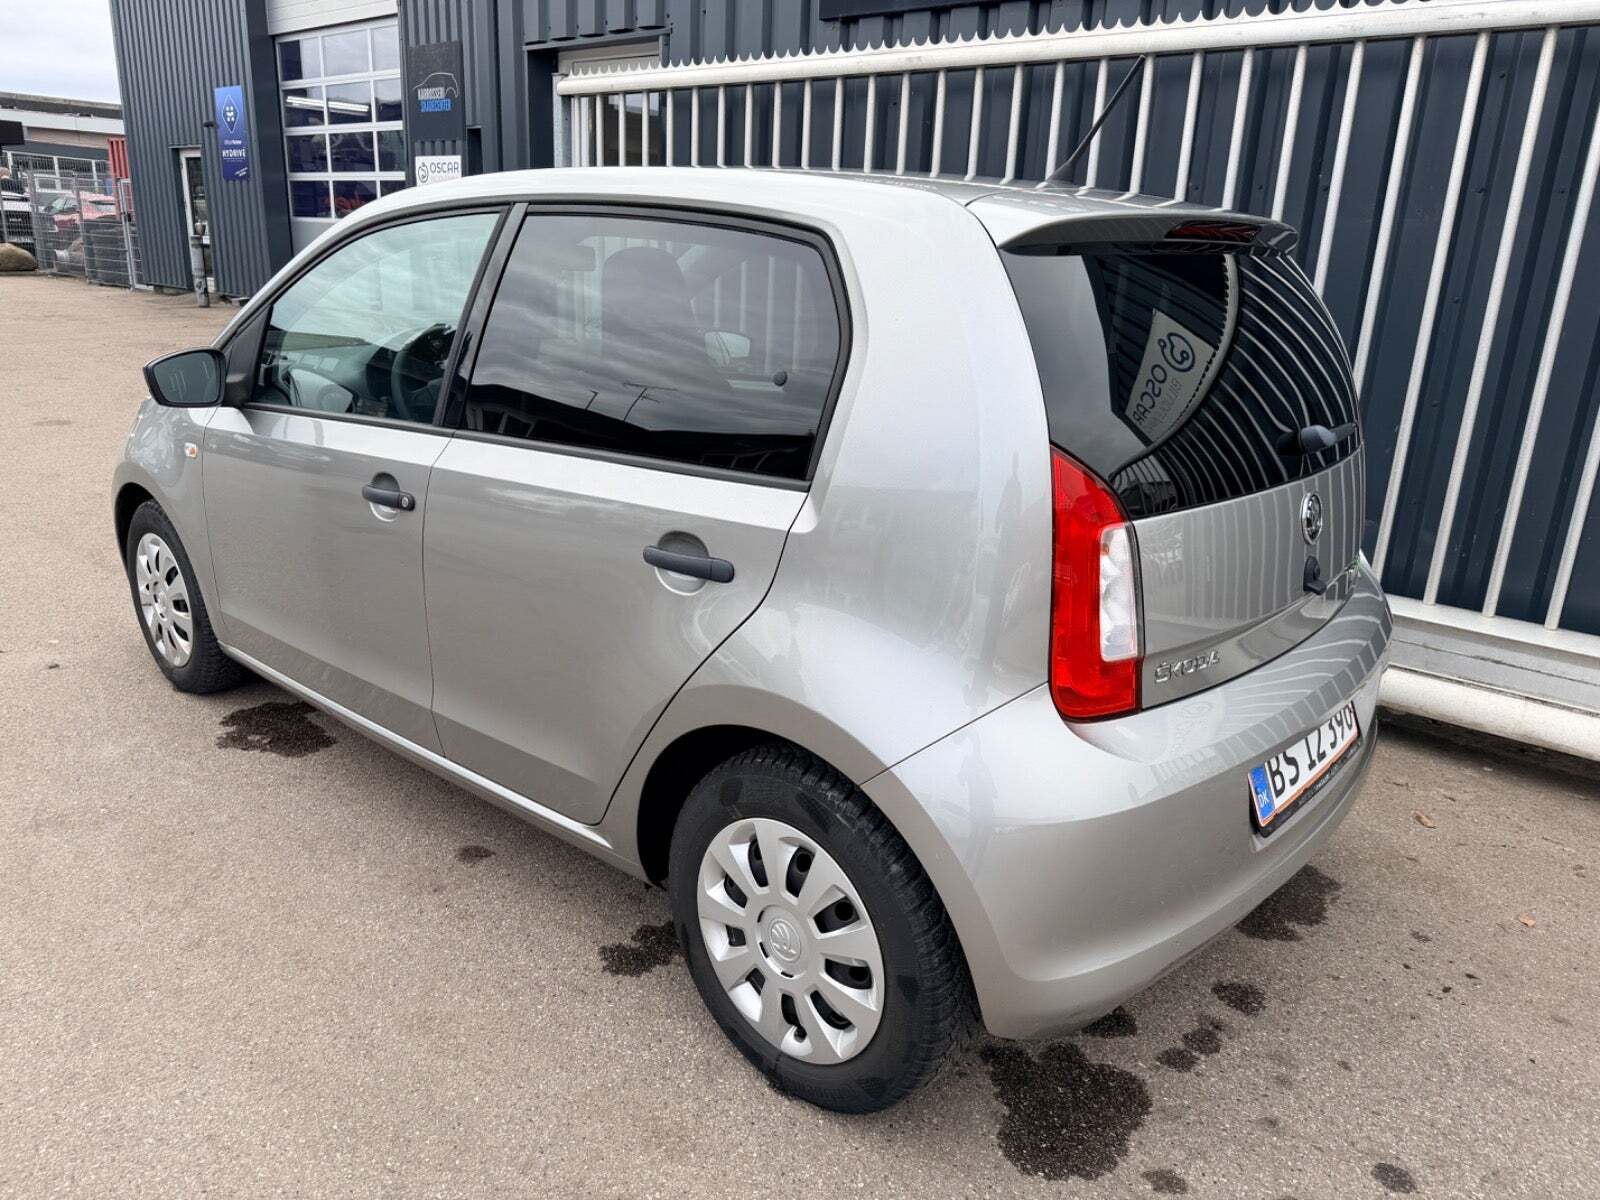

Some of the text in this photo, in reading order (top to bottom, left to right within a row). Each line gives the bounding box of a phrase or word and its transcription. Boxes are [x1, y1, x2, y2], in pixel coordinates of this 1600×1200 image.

[430, 161, 460, 174] OSCAR
[1266, 751, 1300, 799] BS
[1304, 728, 1327, 771] 12
[1257, 789, 1269, 808] DK
